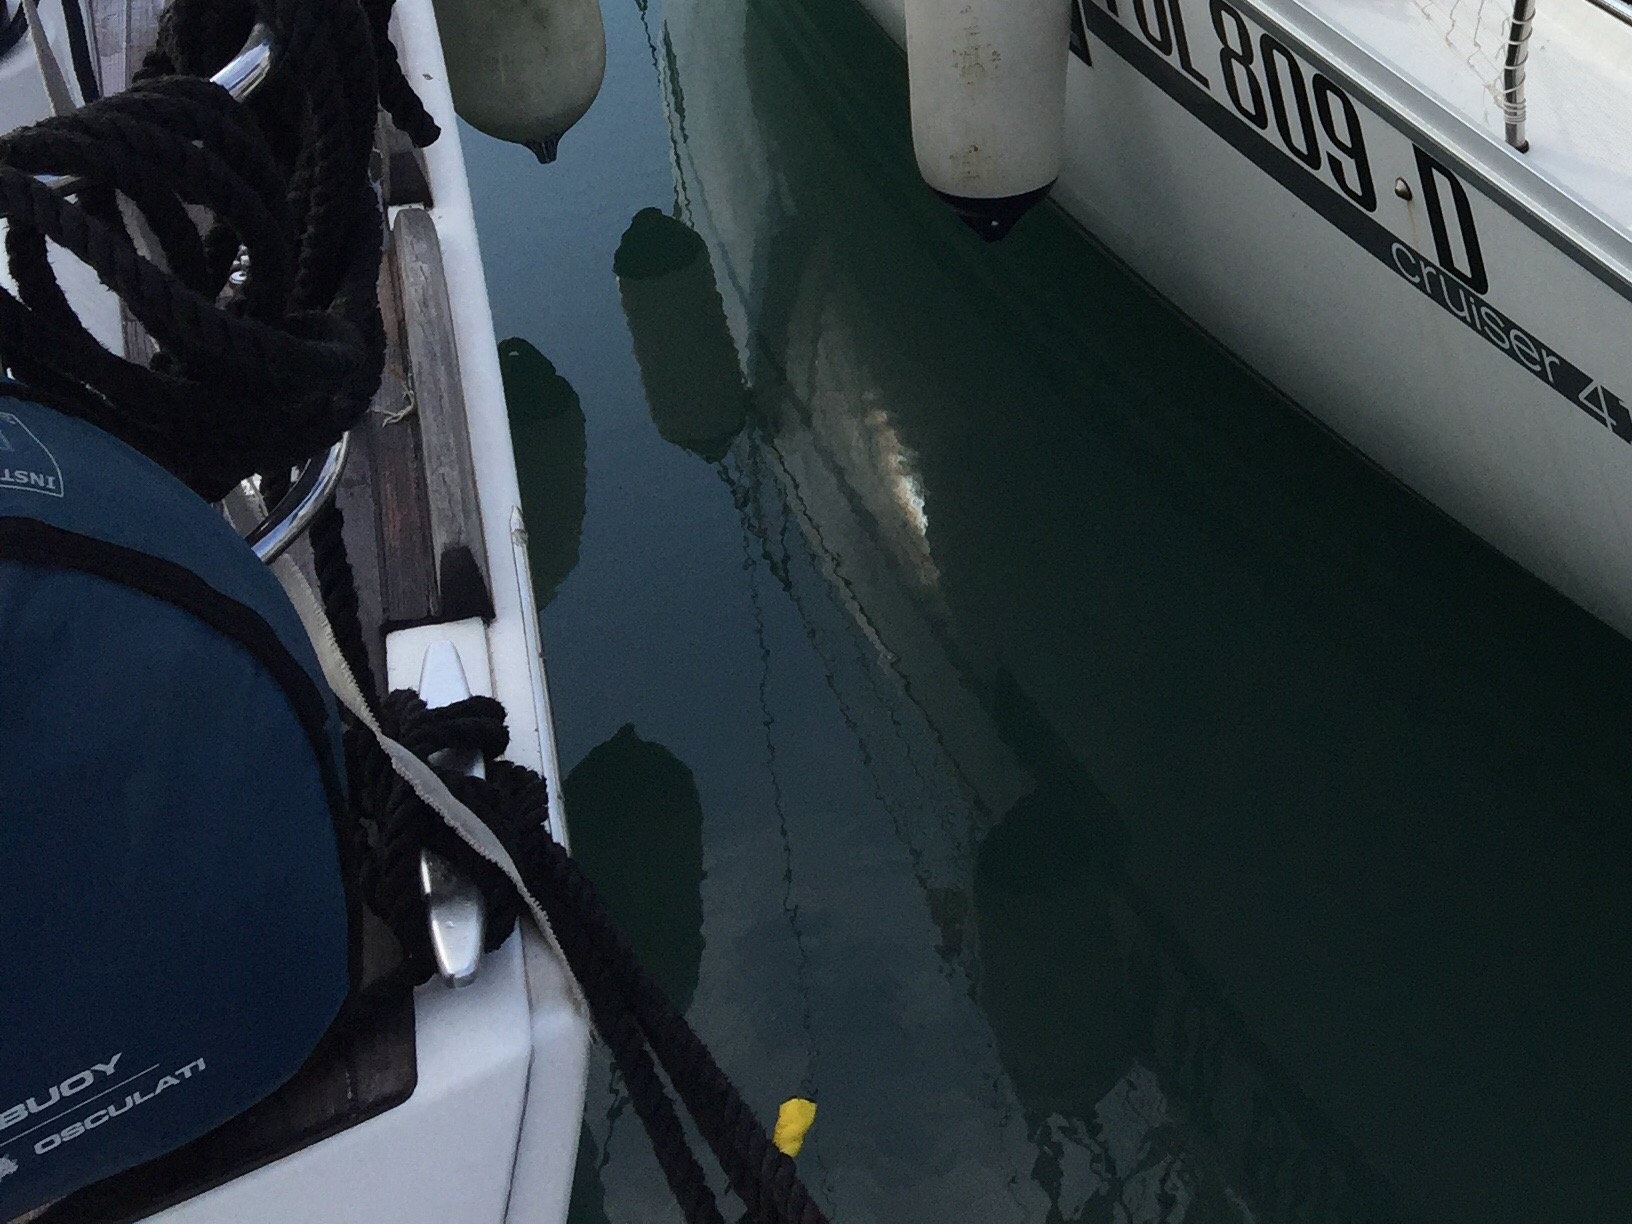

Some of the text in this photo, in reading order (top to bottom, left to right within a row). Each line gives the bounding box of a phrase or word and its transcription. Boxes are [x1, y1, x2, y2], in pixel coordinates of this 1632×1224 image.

[1411, 142, 1490, 296] D
[1391, 242, 1561, 383] cruiser
[0, 1052, 122, 1129] BUOY
[33, 1057, 207, 1155] OSCULATI
